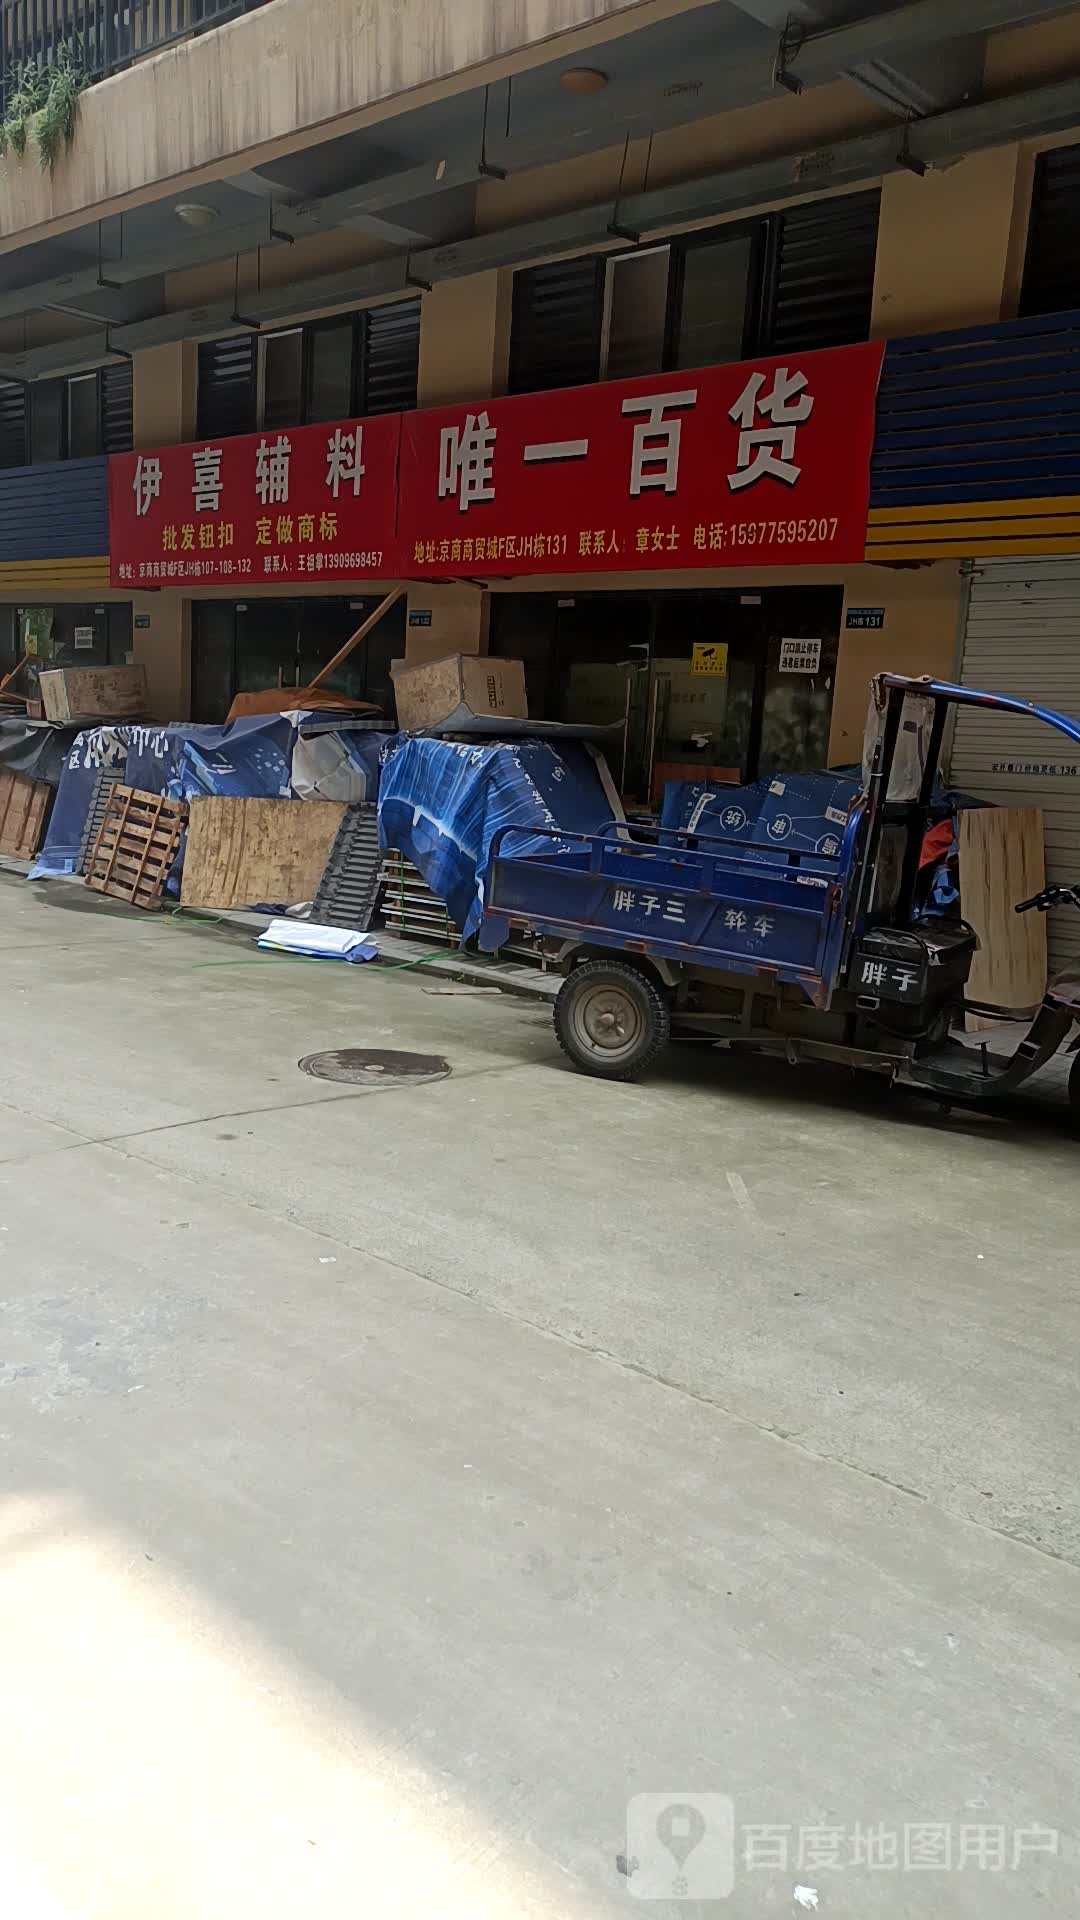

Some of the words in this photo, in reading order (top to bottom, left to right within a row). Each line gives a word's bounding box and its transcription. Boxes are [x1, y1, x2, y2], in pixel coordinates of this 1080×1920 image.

[438, 367, 815, 511] 唯一百货
[133, 426, 365, 516] 伊喜辅料
[162, 521, 234, 551] 批发钮扣
[255, 512, 338, 545] 定做商标
[612, 889, 776, 938] 胖子三轮车
[860, 961, 919, 991] 胖子
